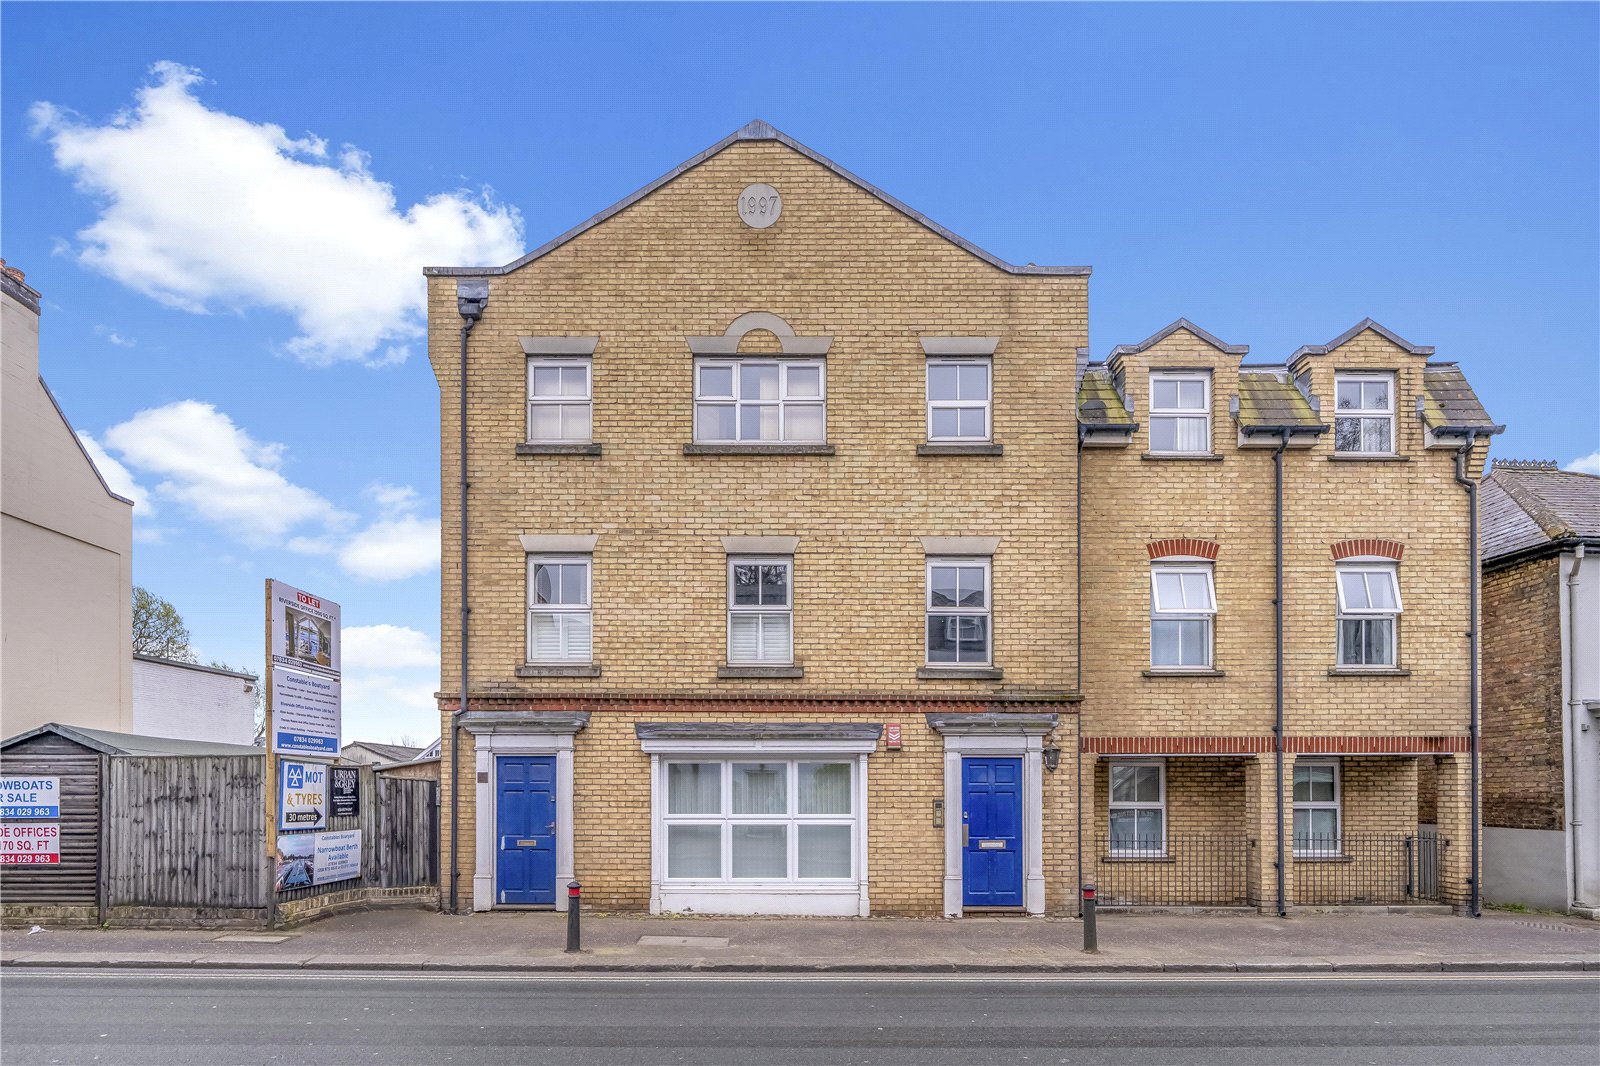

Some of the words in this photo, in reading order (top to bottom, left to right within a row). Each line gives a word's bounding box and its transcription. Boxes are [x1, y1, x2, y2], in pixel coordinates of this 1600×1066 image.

[740, 196, 778, 216] 1997
[279, 596, 299, 608] RIVERSIDE
[300, 604, 314, 614] OFFICE
[298, 593, 307, 603] TO
[308, 597, 319, 607] LET
[287, 676, 311, 686] Constable's
[312, 681, 330, 690] Boatyard
[305, 771, 323, 784] MOT
[334, 770, 356, 780] URBAN
[0, 780, 53, 790] WBOATS
[7, 793, 37, 802] SALE
[287, 793, 294, 807] &
[295, 794, 322, 805] TYRES
[14, 827, 57, 837] OFFICES
[0, 841, 13, 850] 70
[17, 841, 33, 851] SQ.
[37, 841, 49, 850] FT
[317, 845, 346, 853] Narrowboat
[328, 853, 349, 861] Available
